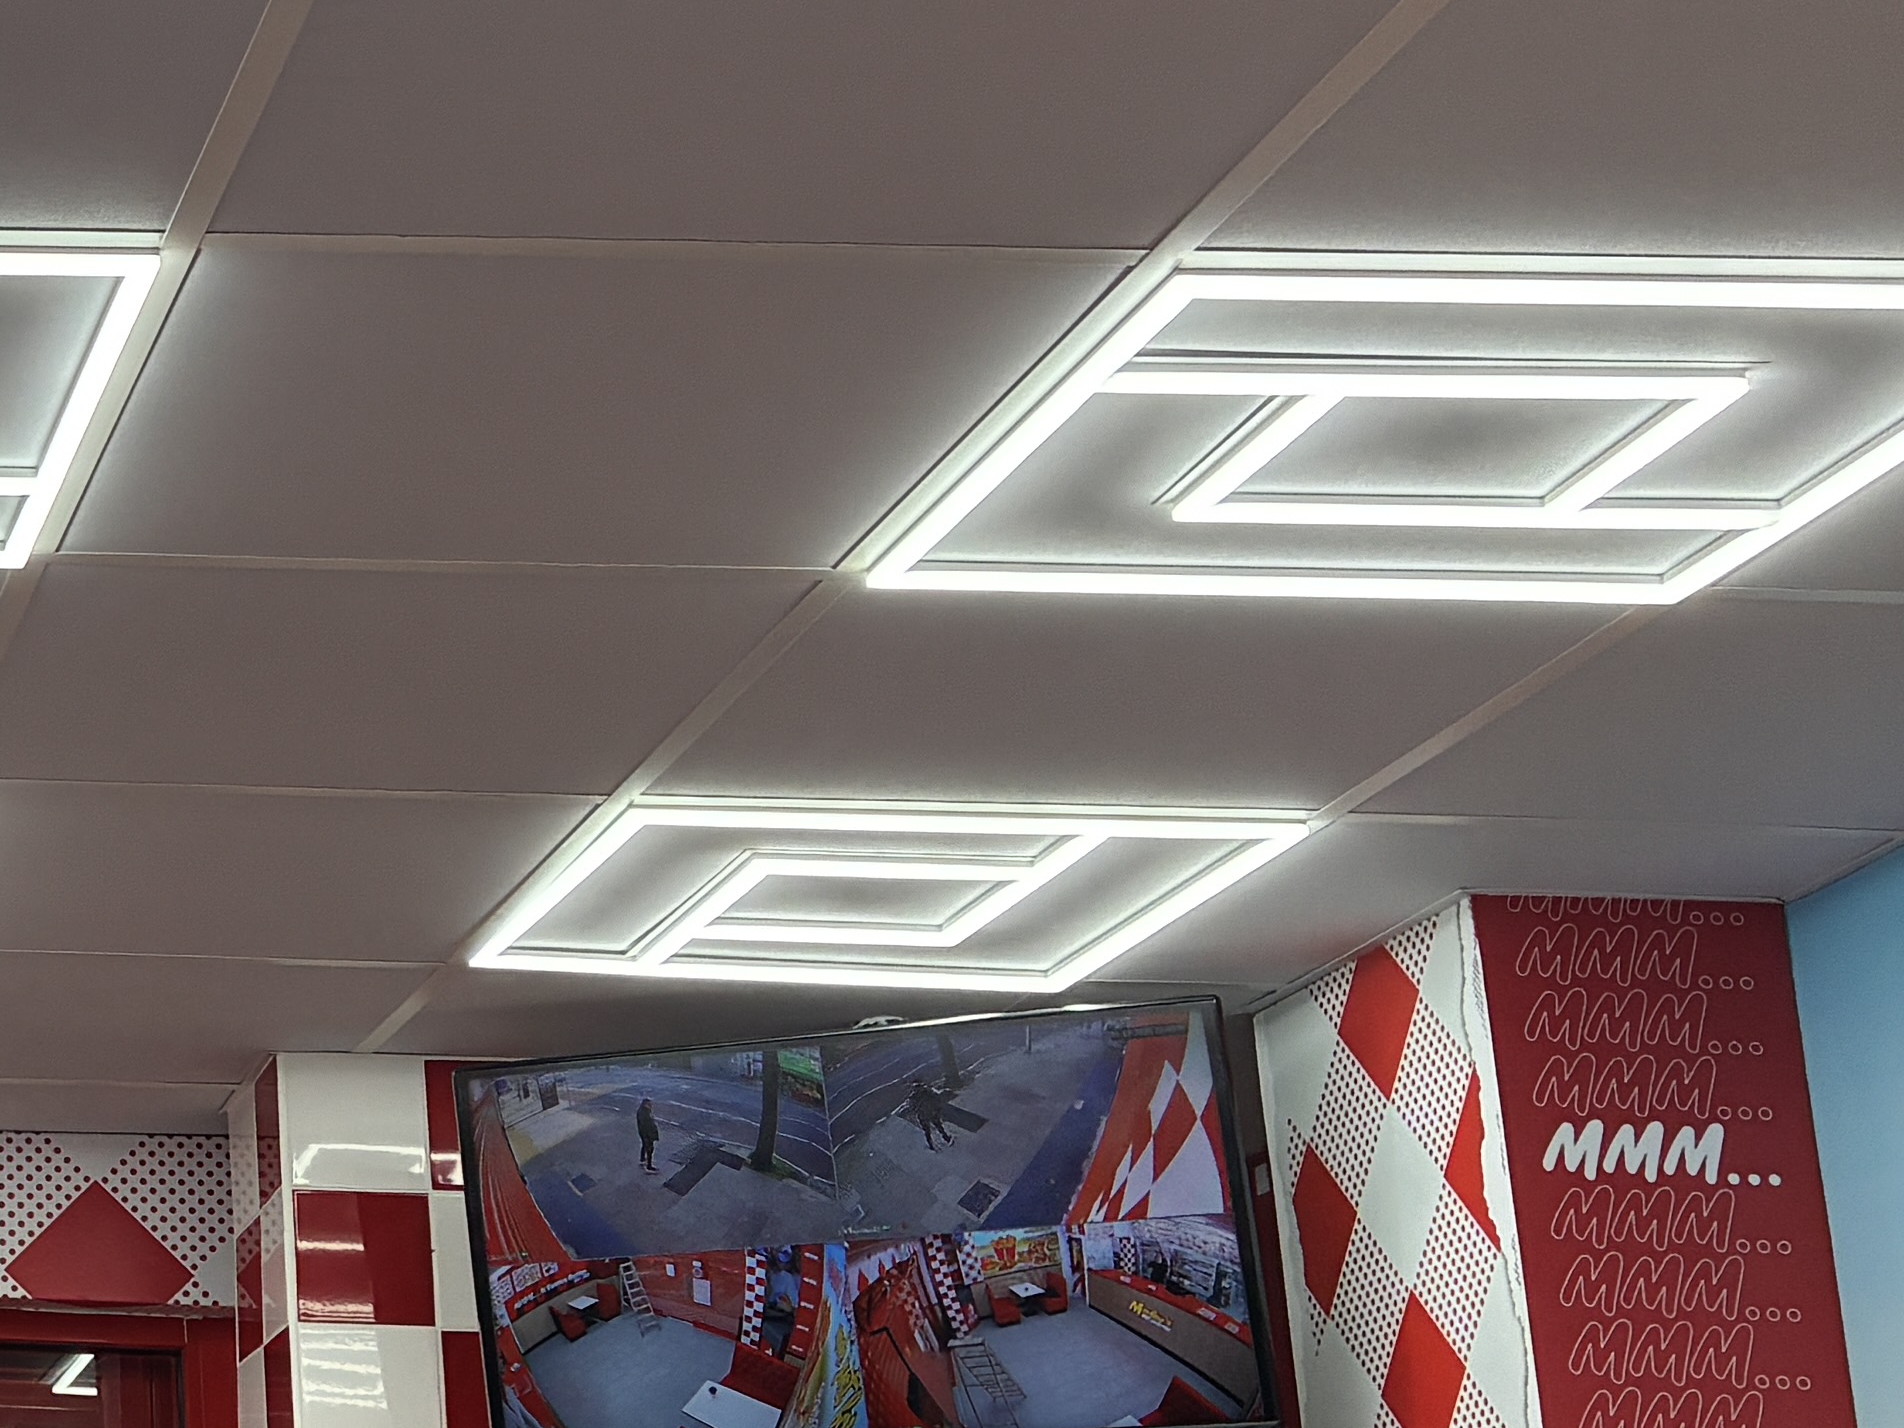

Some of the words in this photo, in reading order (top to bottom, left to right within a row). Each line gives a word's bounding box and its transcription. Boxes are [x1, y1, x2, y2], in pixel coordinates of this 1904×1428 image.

[1516, 924, 1754, 990] MMM...
[1525, 988, 1763, 1055] MMM...
[1533, 1053, 1772, 1120] MMM...
[1543, 1119, 1781, 1187] MMM...
[1550, 1185, 1791, 1254] MMM...
[1559, 1251, 1801, 1322] MMM...
[1568, 1319, 1811, 1390] MMM...
